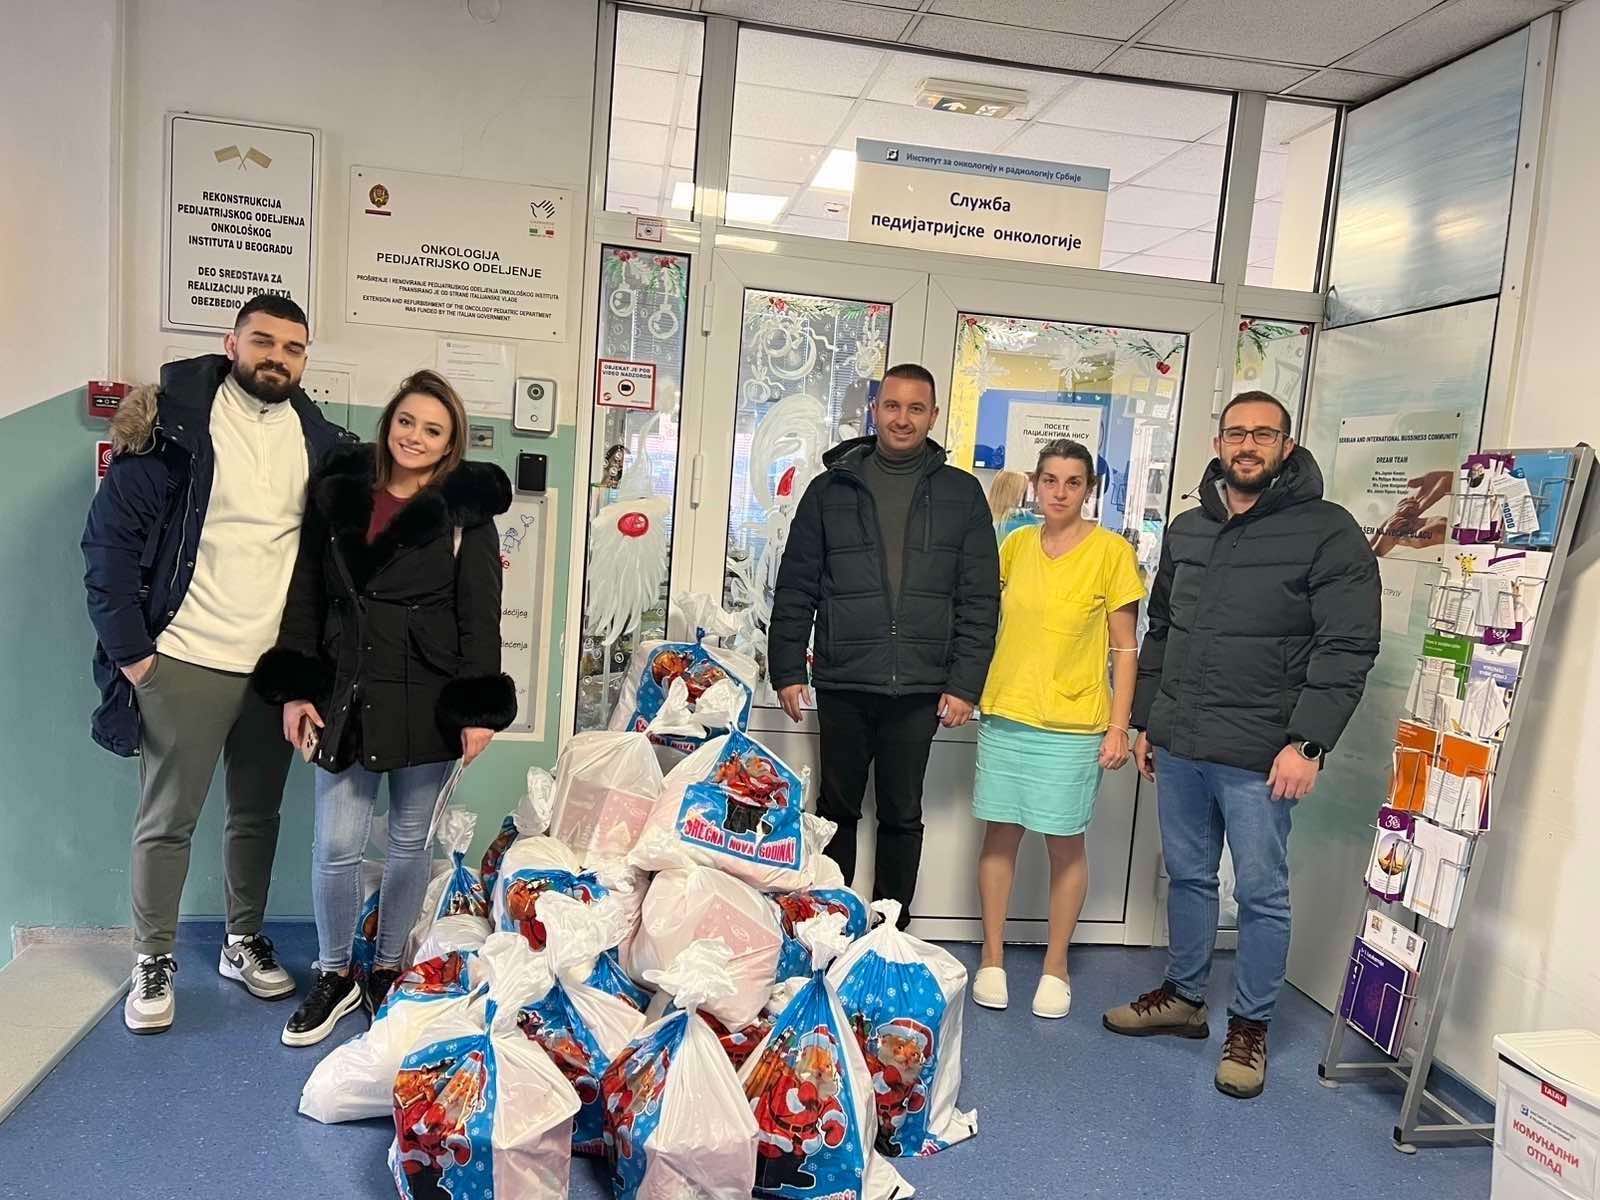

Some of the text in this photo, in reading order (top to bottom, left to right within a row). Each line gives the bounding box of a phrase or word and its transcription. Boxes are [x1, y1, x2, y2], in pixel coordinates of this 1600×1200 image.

[906, 153, 942, 165] Институт
[953, 161, 997, 173] онкологију
[1005, 166, 1054, 180] радиологију
[1055, 171, 1082, 183] Србије
[202, 191, 282, 209] REKONSTRUKCIJA
[949, 191, 1011, 213] Служба
[177, 203, 305, 226] PEDIJATRIJSKOG ODELJENJA
[211, 222, 272, 238] ONKOLOŠKOG
[871, 213, 1082, 251] педијатријске онкологије
[188, 235, 293, 255] INSTITUTA U BEOGRADU
[421, 243, 500, 261] ONKOLOGIJA
[376, 252, 542, 279] PEDIJATRIJSKO ODELJENJE
[198, 266, 282, 284] DEO SREDSTAVA ZA
[188, 280, 245, 295] REALIZACIJU
[191, 296, 241, 309] OBEZBEDIO
[1023, 429, 1071, 438] ПАЦИЈЕНТИМА
[1044, 423, 1070, 431] ПОСЕТЕ
[729, 839, 754, 855] NOVA
[1513, 1119, 1580, 1168] КОМУНАЛНИ
[1527, 1145, 1562, 1176] ОТПАД
